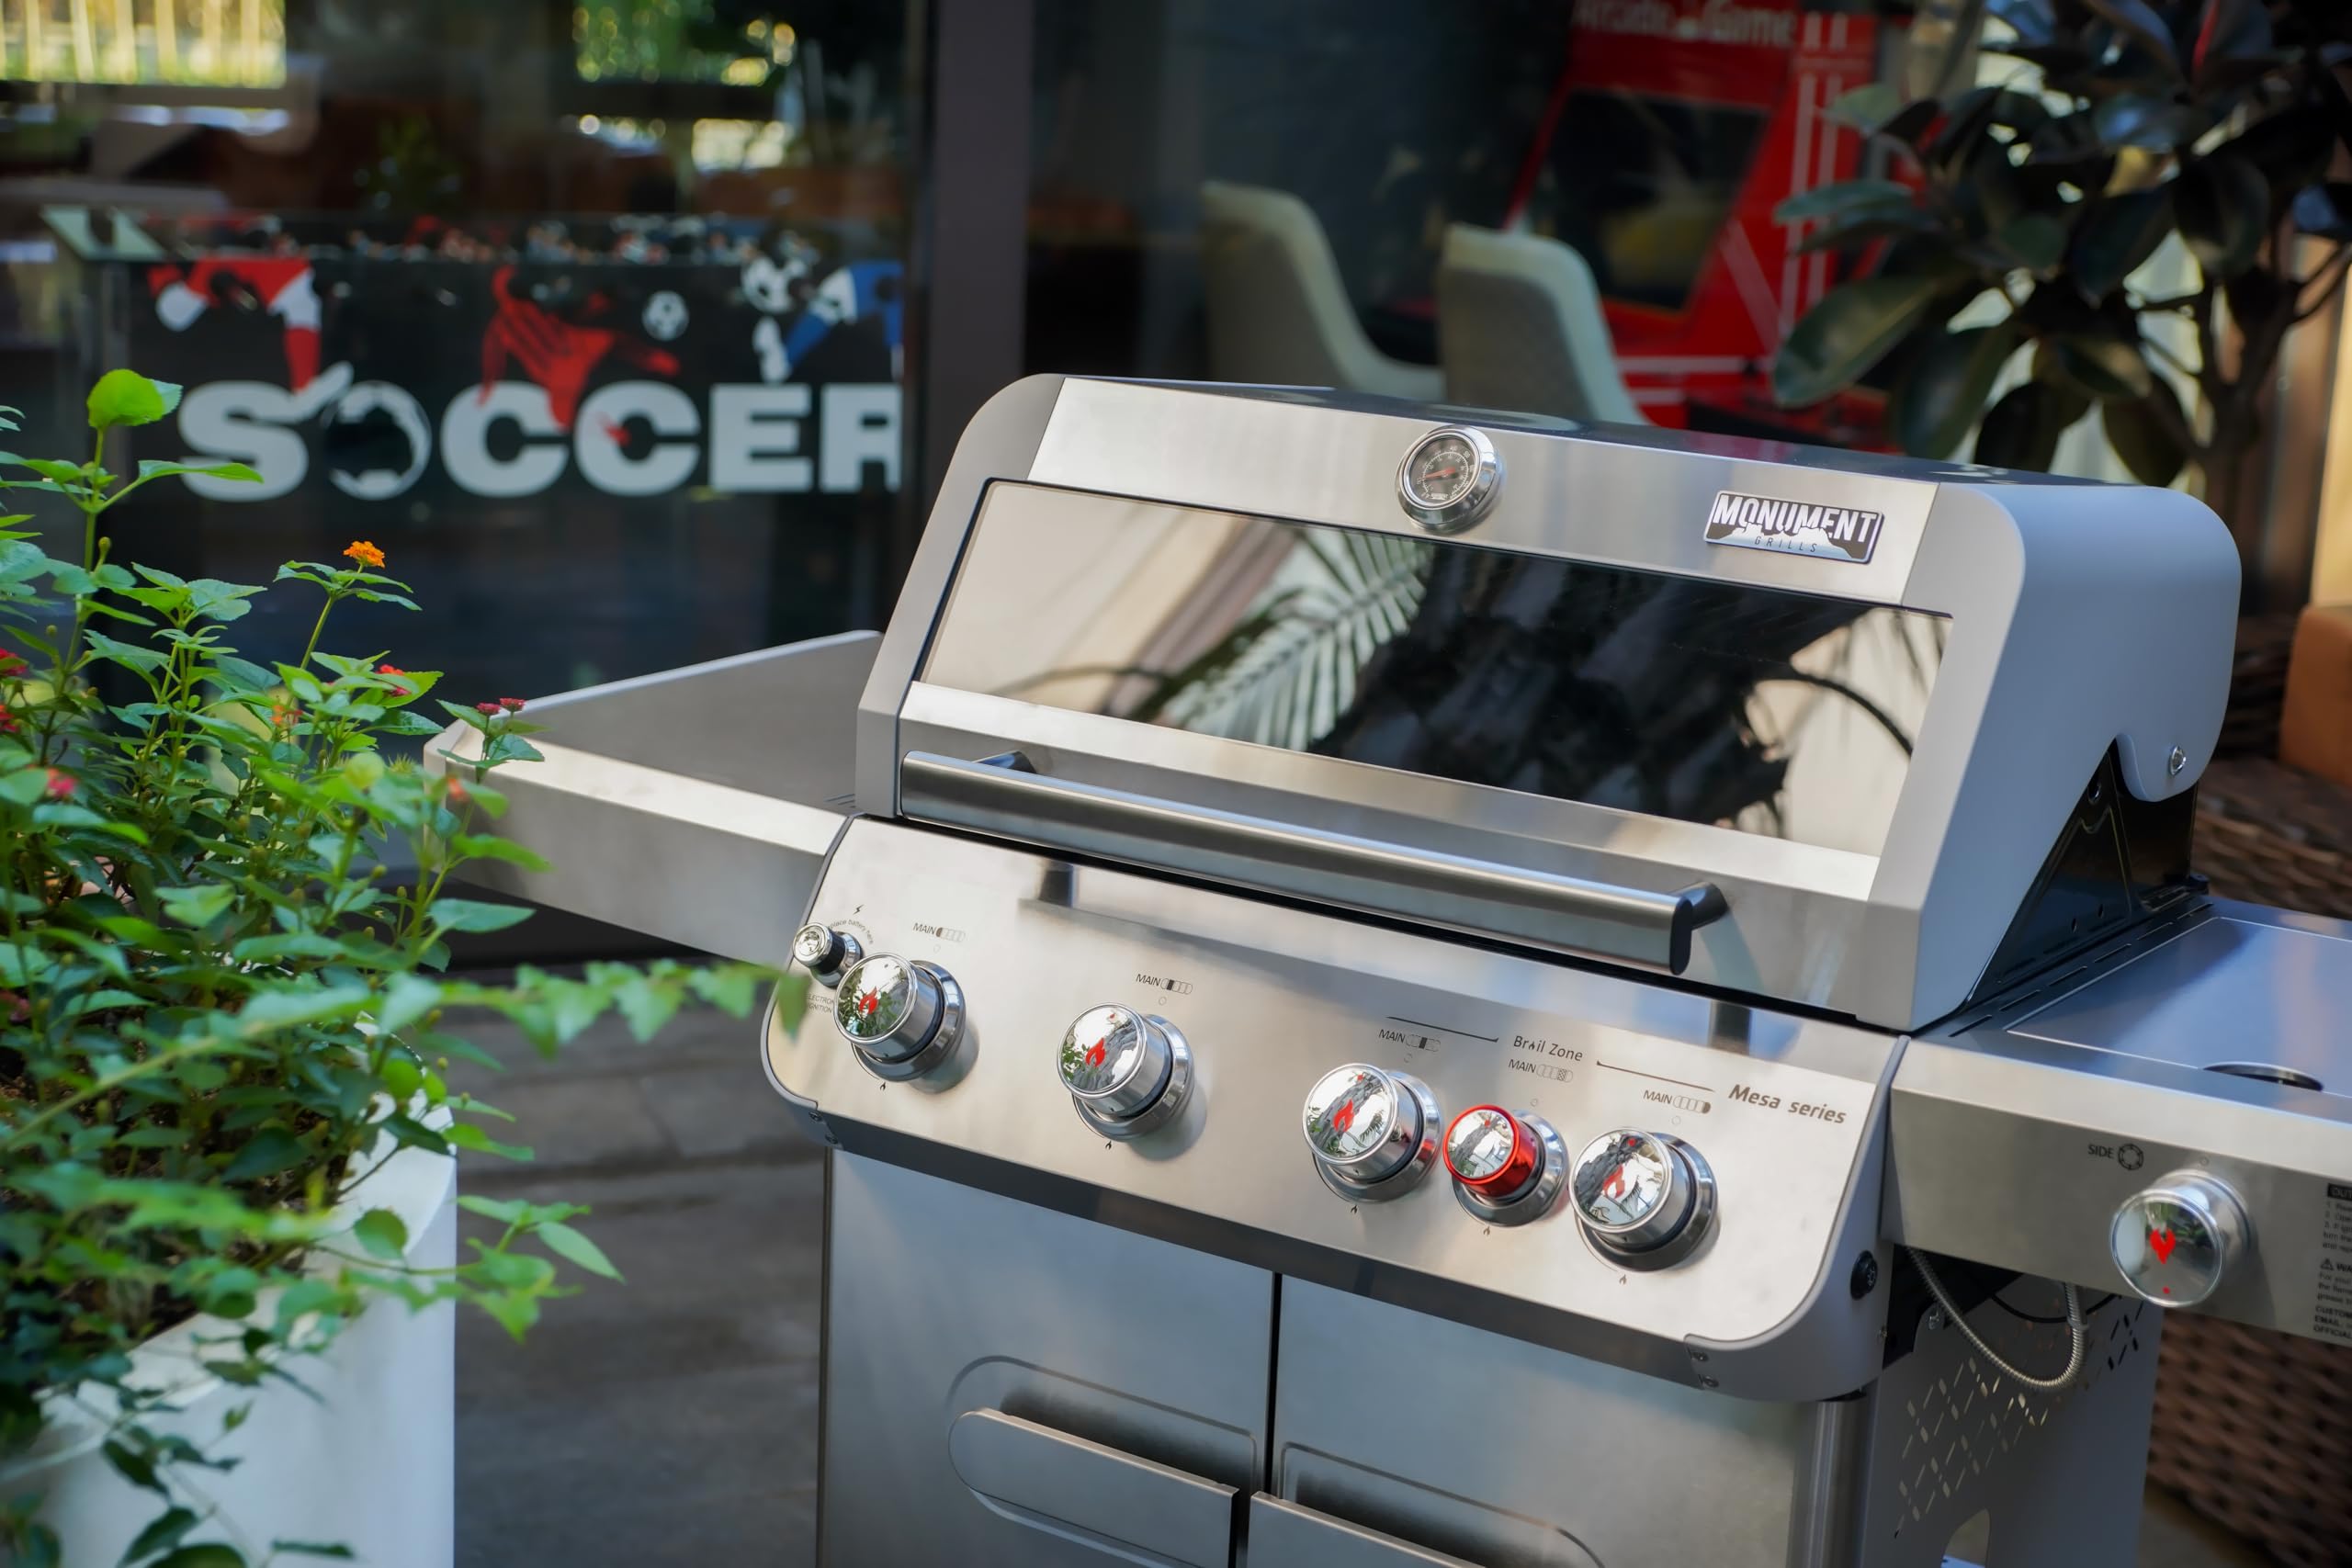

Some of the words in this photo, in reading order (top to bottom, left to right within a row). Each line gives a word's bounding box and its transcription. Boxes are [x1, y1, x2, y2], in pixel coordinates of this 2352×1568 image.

[175, 378, 903, 502] SOCCER
[1712, 494, 1878, 543] MONUMENT
[1754, 536, 1817, 553] GRILLS
[912, 922, 936, 935] MAIN
[1136, 973, 1161, 987] MAIN
[1378, 1029, 1406, 1044] MAIN
[1549, 1043, 1584, 1062] Zone
[1508, 1059, 1536, 1074] MAIN
[1643, 1089, 1673, 1105] MAIN
[1728, 1084, 1781, 1110] Mesa
[1788, 1100, 1847, 1124] series
[2087, 1144, 2114, 1159] SIDE
